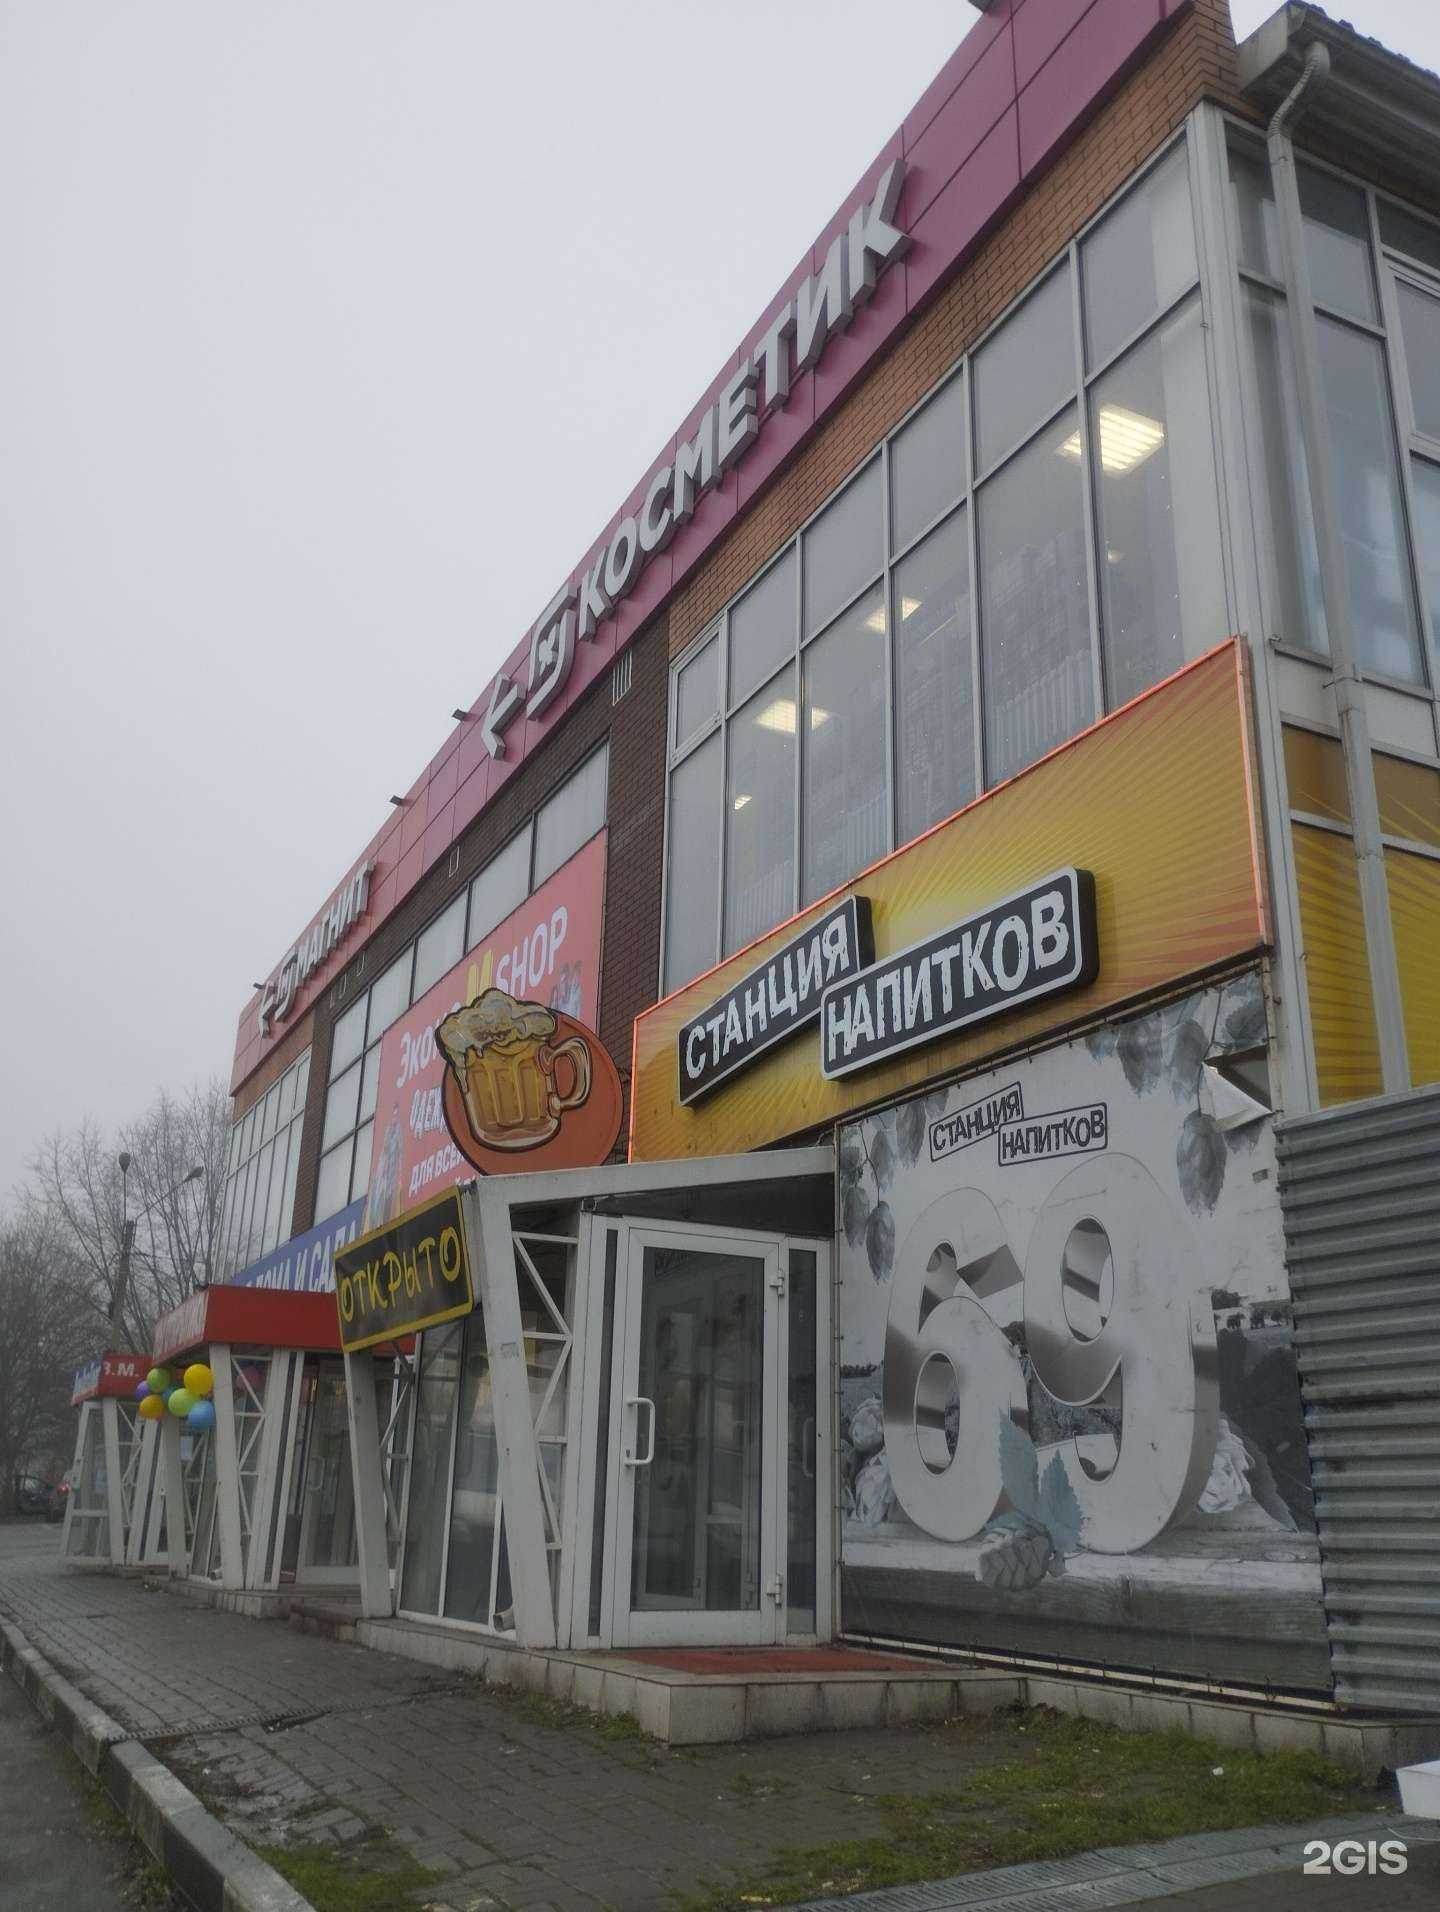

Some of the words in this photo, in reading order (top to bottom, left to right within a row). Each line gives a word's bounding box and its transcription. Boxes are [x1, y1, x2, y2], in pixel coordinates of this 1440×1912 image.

[578, 158, 912, 642] КОСМЕТИК
[296, 860, 375, 986] МАГНИТ
[827, 890, 1071, 1061] НАПИТКОВ
[685, 913, 851, 1080] СТАНЦИЯ
[932, 1090, 1021, 1152] СТАНЦИЯ
[1001, 1111, 1106, 1160] НАПИТКОВ
[340, 1225, 461, 1322] ОТКРЫТО
[883, 1152, 1219, 1554] 69
